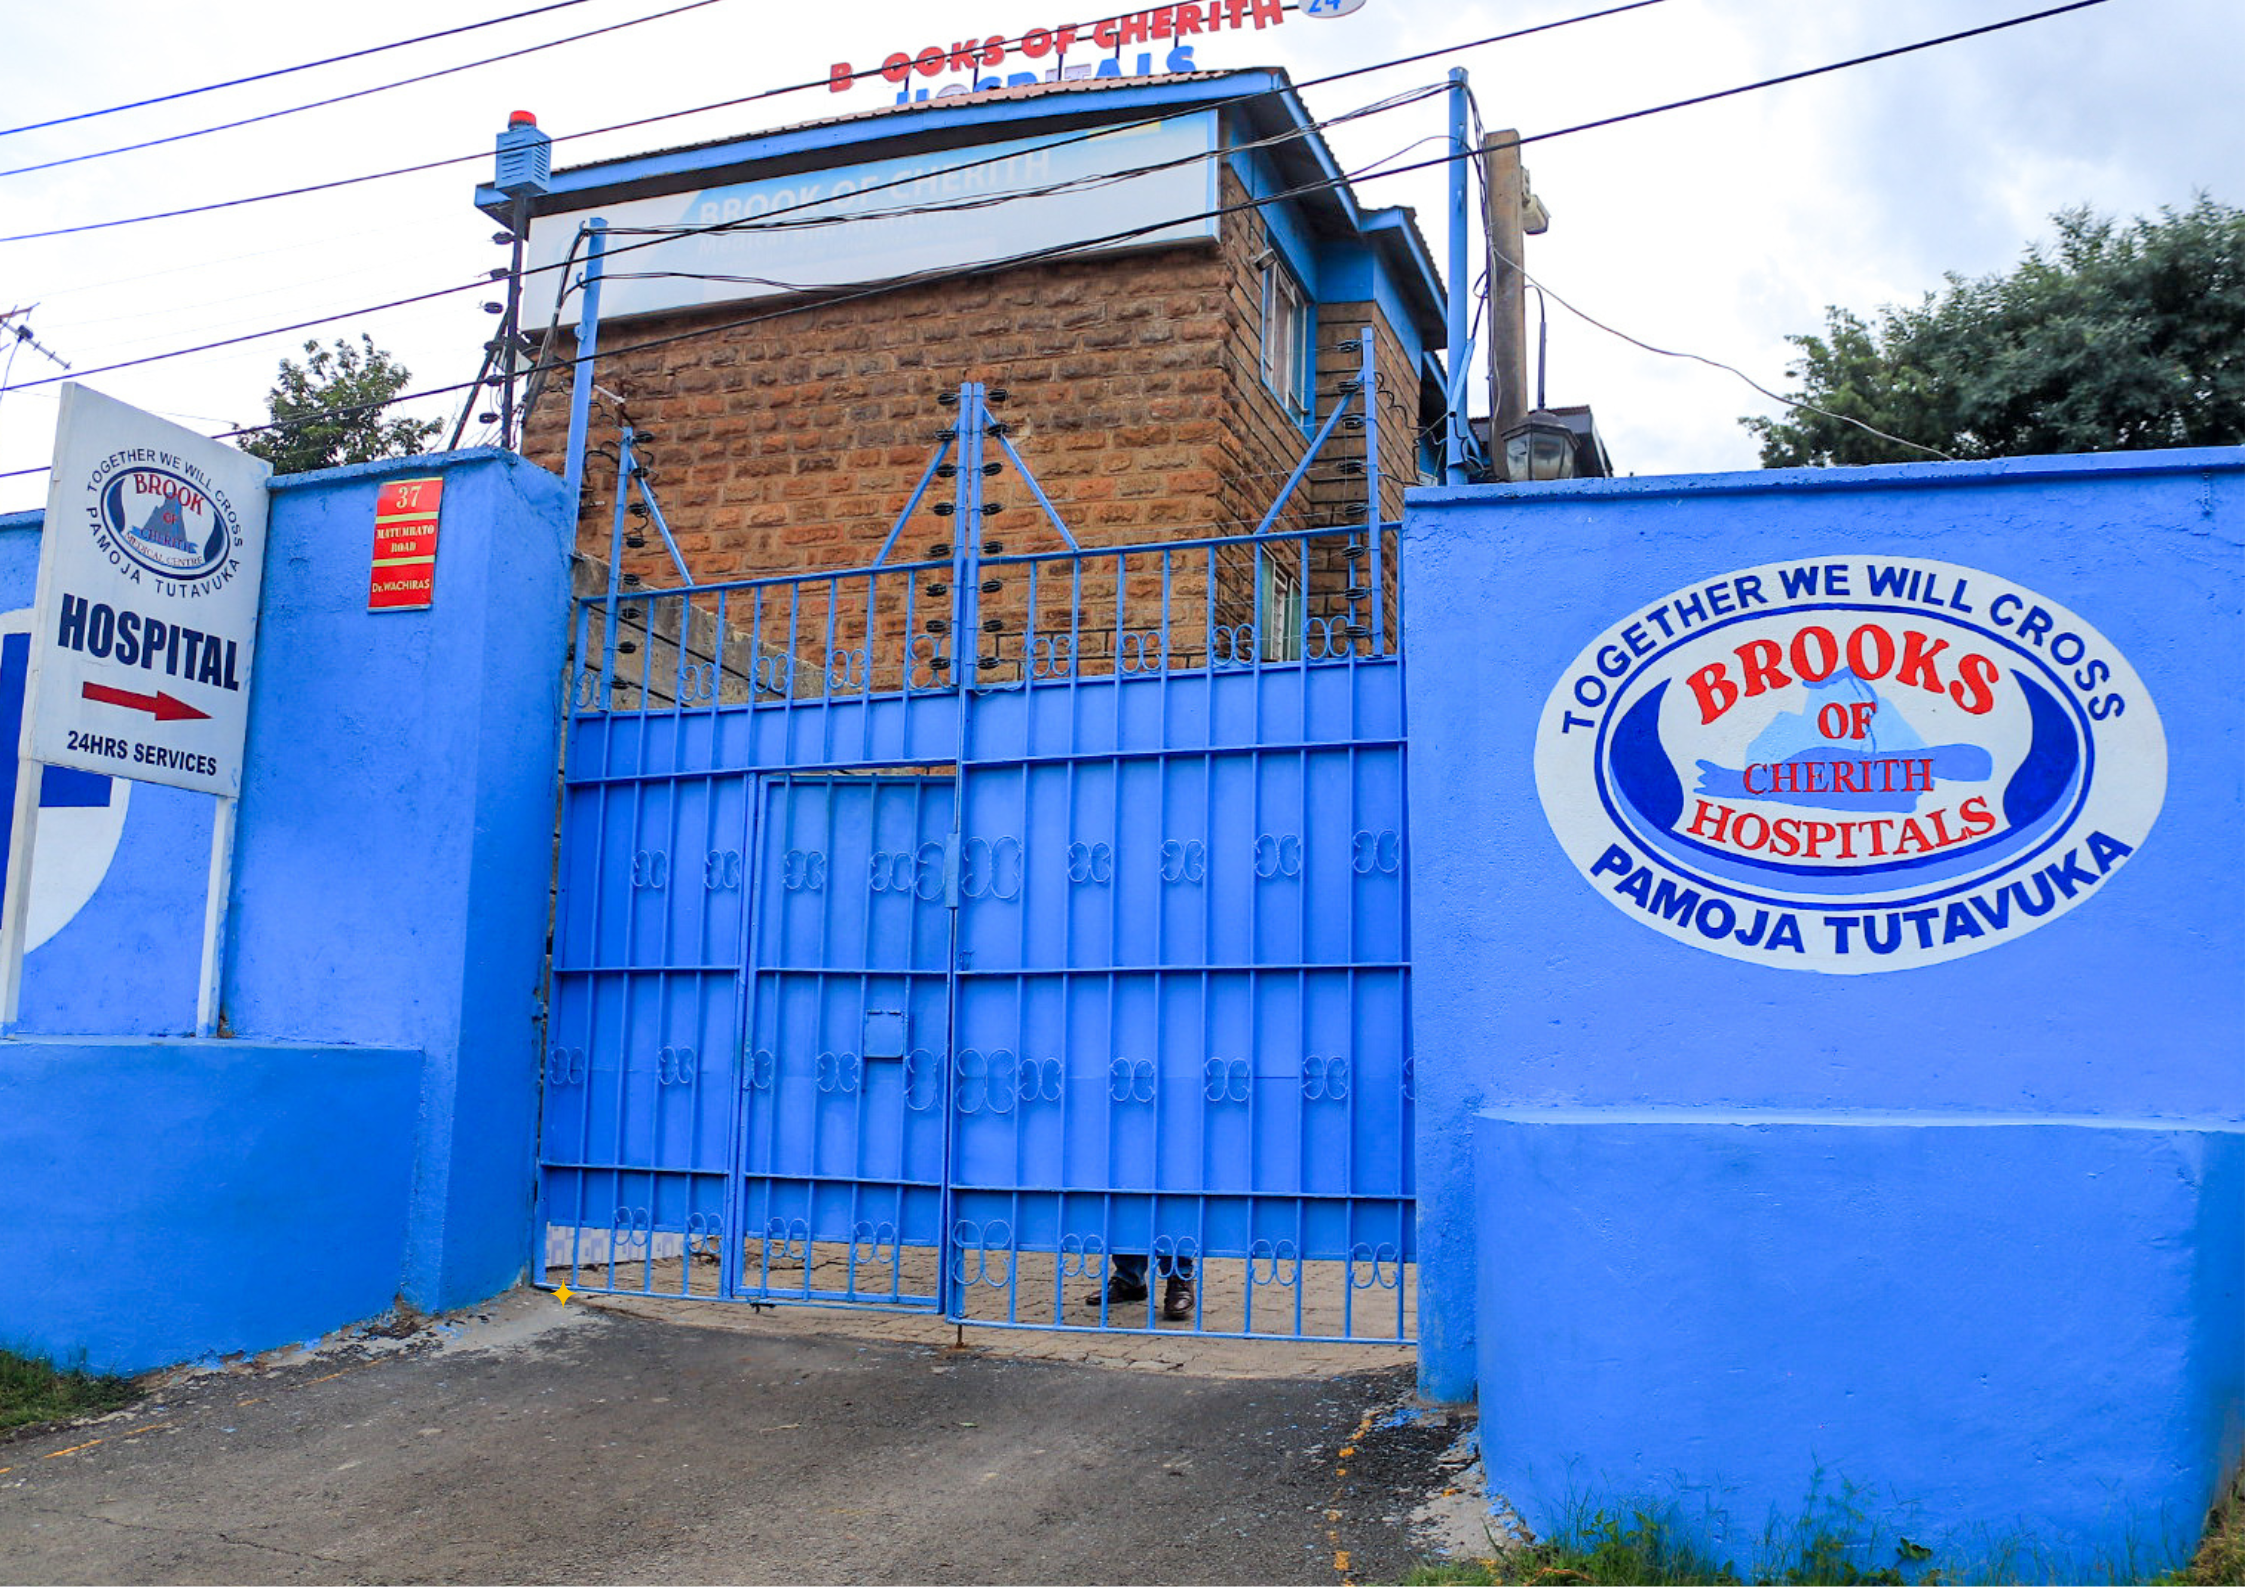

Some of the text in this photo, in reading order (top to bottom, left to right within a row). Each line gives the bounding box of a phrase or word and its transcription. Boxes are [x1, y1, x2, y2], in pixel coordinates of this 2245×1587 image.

[1021, 22, 1077, 59] OF
[1093, 0, 1284, 49] CHERITH
[87, 449, 243, 547] TOGETHER WE WILL CROSS
[134, 474, 204, 516] BROOK
[163, 512, 178, 525] OF
[396, 485, 422, 509] 37
[86, 507, 240, 598] PAMOJA TUTAVUKA
[125, 531, 203, 568] MEDICAL CENTRE
[140, 529, 194, 554] CHERITH
[391, 541, 417, 553] ROAD
[57, 593, 239, 692] HOSPITAL
[1562, 564, 2125, 736] TOGETHER WE WILL CROSS
[1685, 623, 1999, 726] BROOKS
[1817, 702, 1877, 740] OF
[67, 729, 217, 776] 24HRS SERVICES
[1743, 758, 1934, 794] CHERITH
[1686, 795, 1997, 859] HOSPITALS
[1589, 830, 2133, 955] PAMOJA TUTAVUKA
